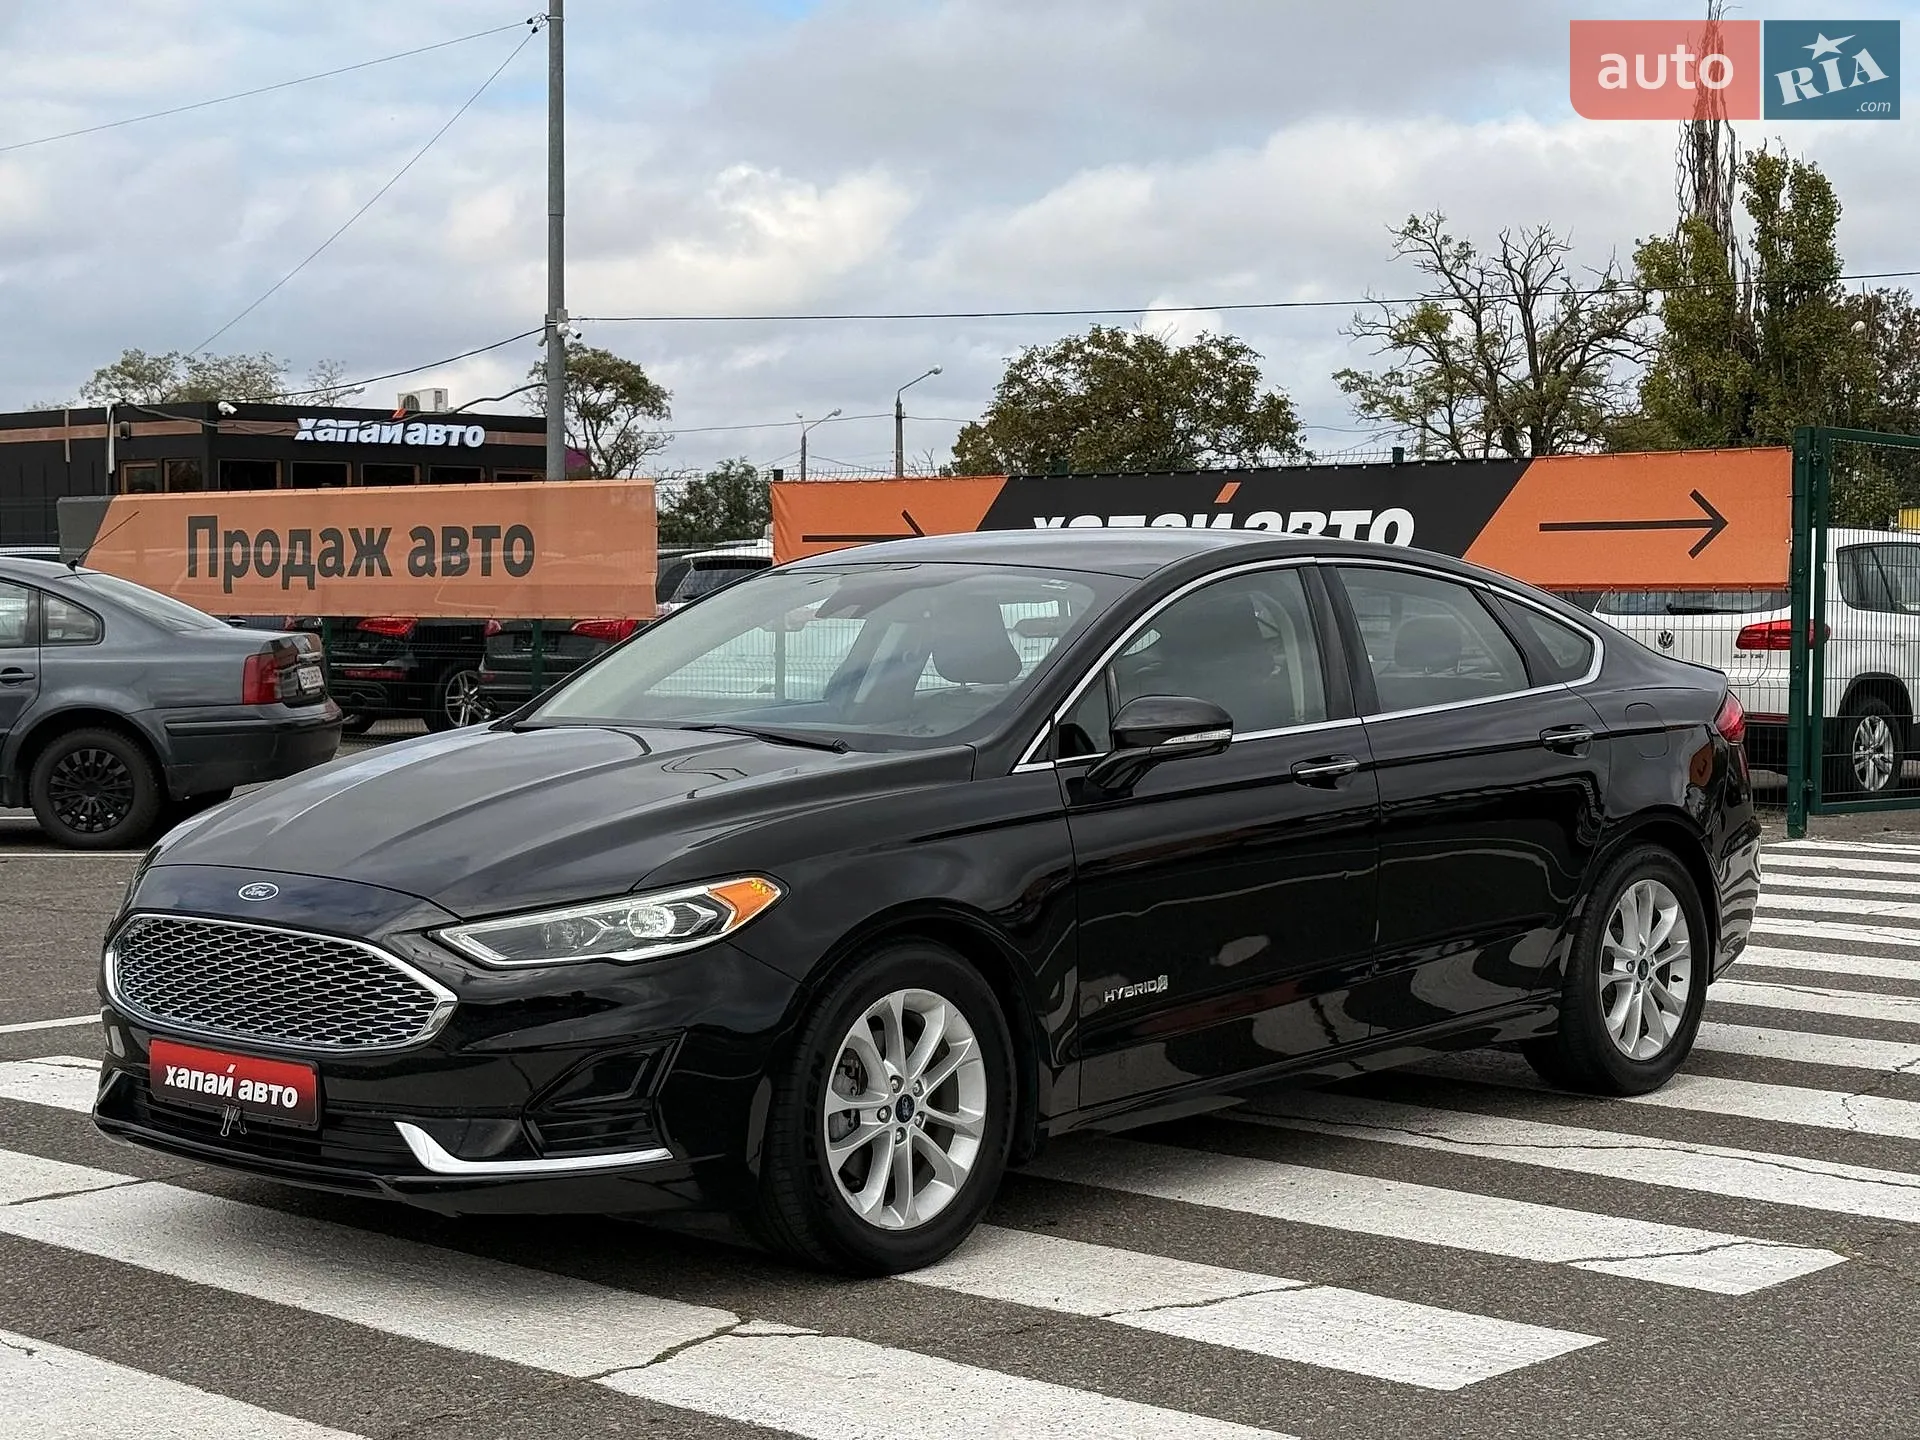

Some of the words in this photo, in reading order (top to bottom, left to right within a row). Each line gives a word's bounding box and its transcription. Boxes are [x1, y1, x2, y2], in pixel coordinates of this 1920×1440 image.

[187, 515, 393, 594] Продаж
[407, 524, 535, 578] авто
[1103, 979, 1158, 1003] HYBRID
[164, 1063, 238, 1098] хапай
[238, 1079, 298, 1109] авто
